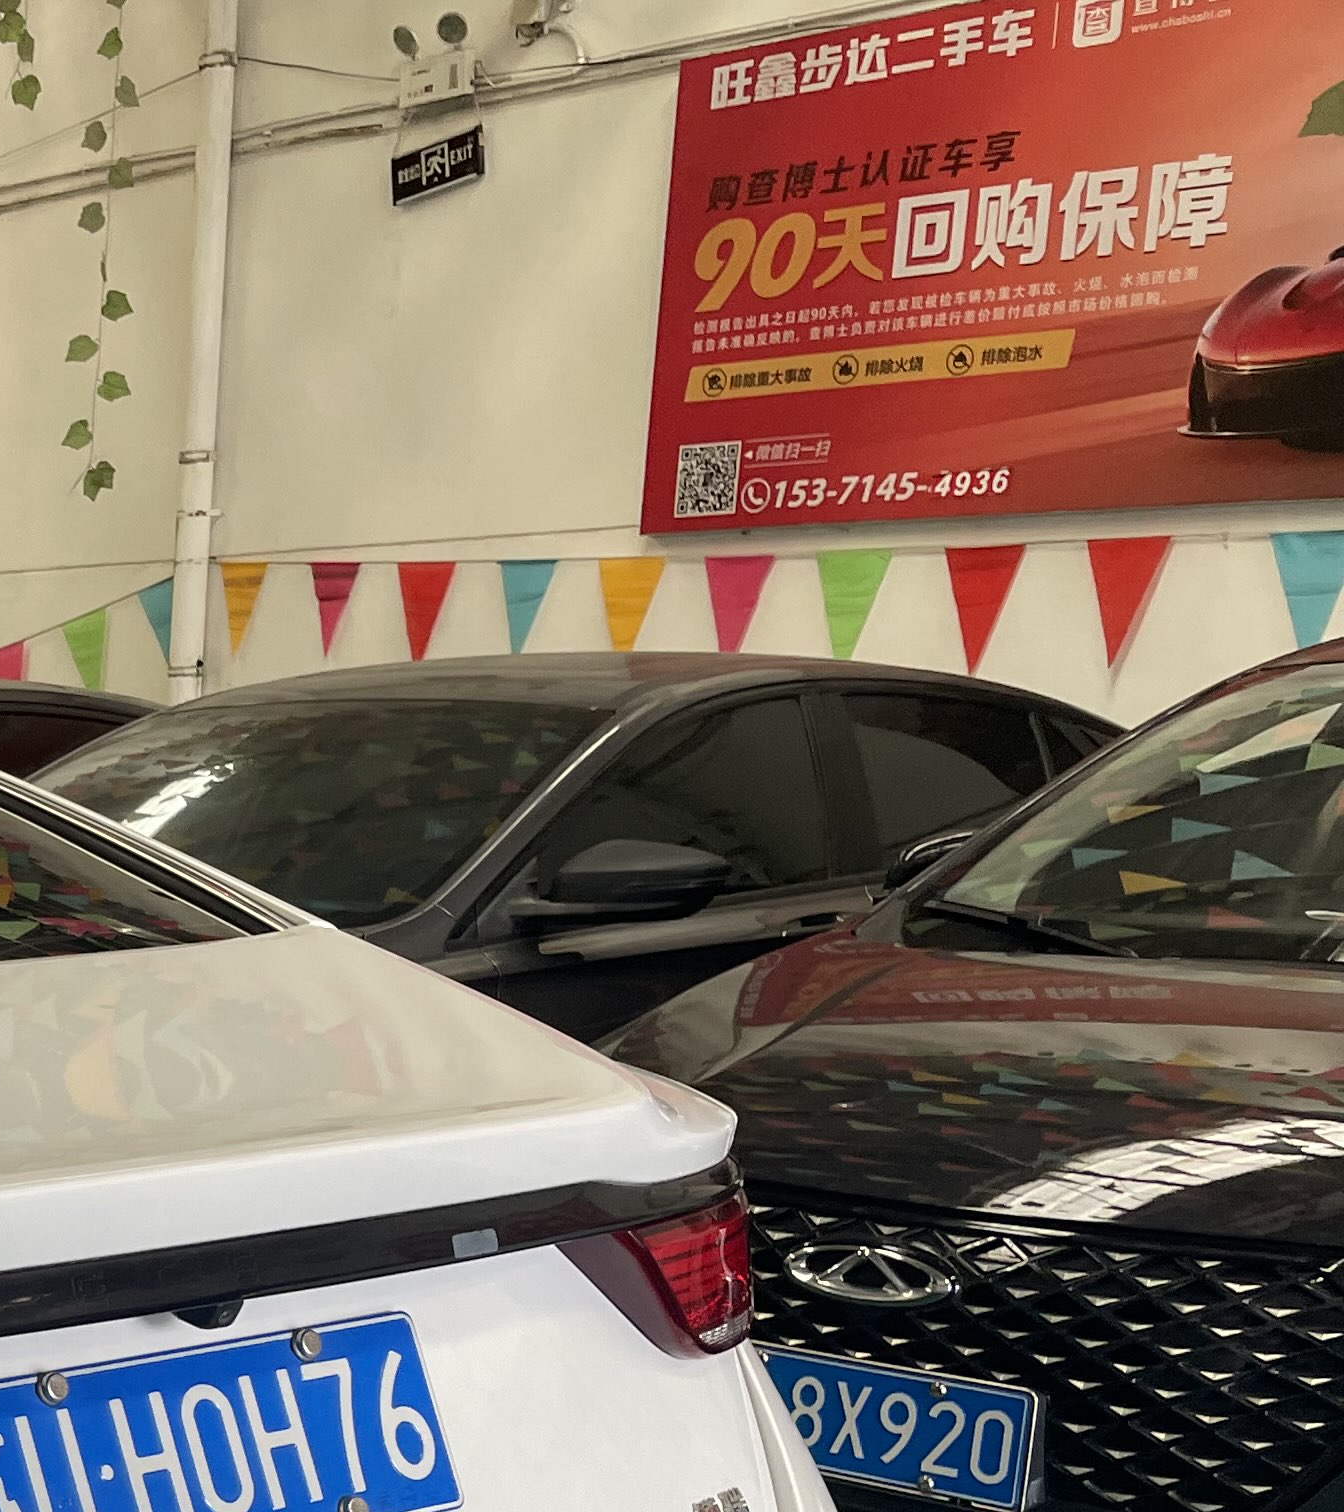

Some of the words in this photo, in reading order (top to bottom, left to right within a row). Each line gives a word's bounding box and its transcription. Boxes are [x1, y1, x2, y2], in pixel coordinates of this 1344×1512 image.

[710, 7, 1035, 110] 旺鑫步达二手车
[449, 143, 473, 166] EXIT
[705, 131, 1021, 213] 购查博士认证车享
[865, 355, 924, 377] 排除火烧
[980, 345, 1043, 366] 排除泡水
[729, 367, 813, 389] 排除重大事故
[755, 440, 831, 461] 微信扫一扫
[774, 467, 1010, 509] 153-7145-4936
[791, 1376, 1013, 1485] 8X920
